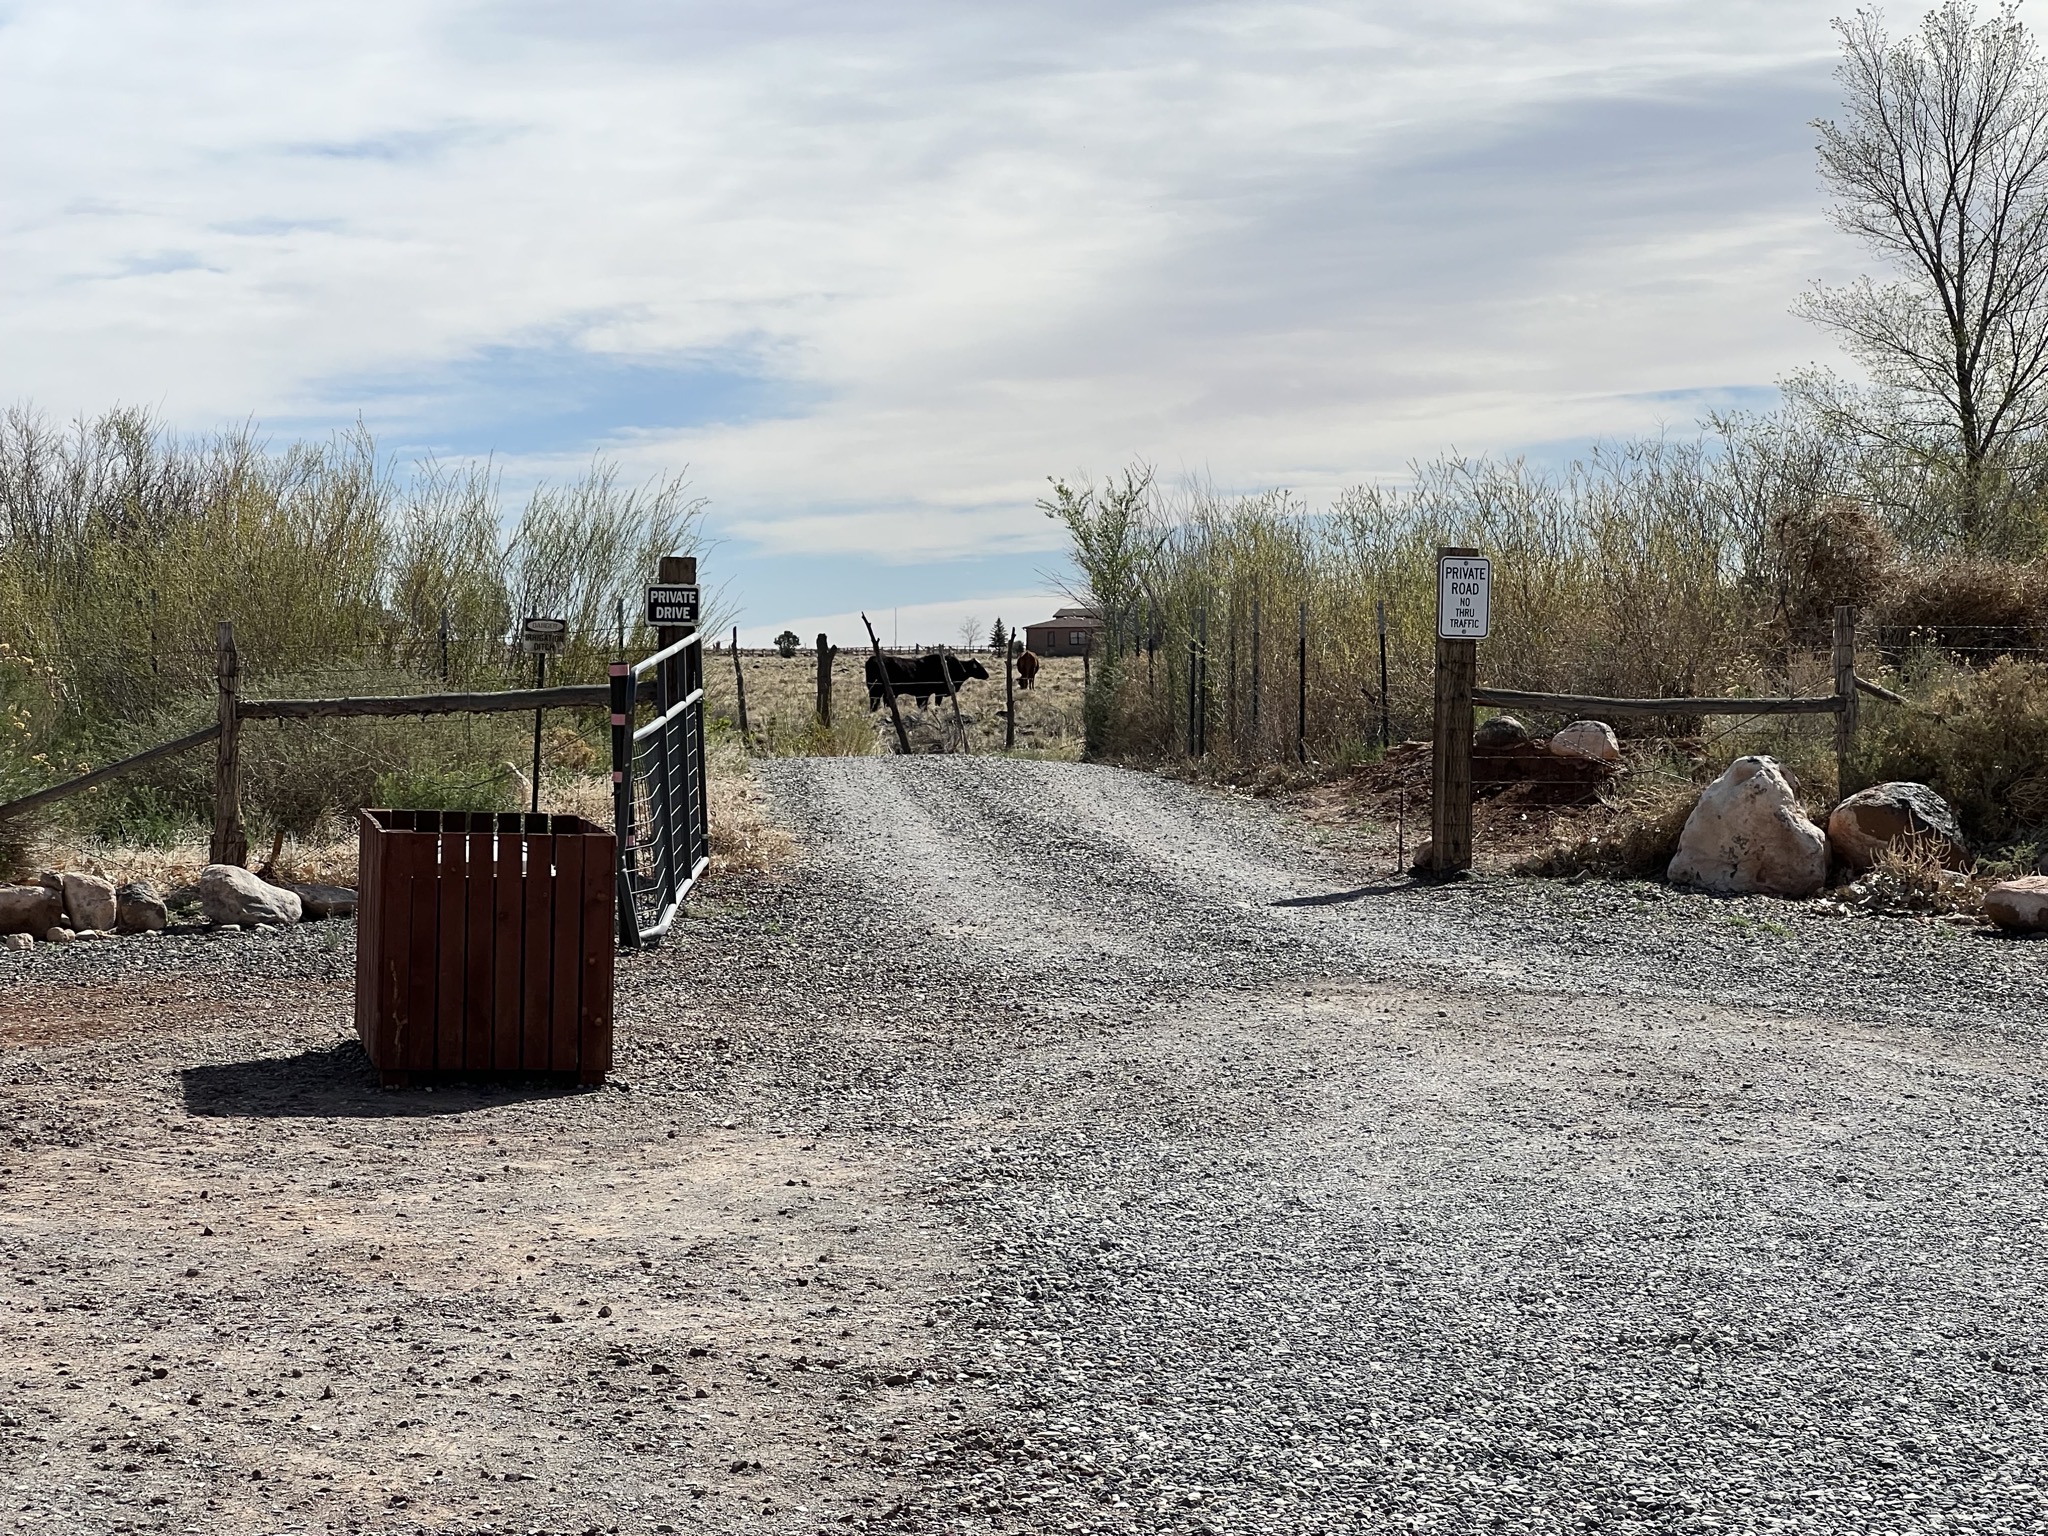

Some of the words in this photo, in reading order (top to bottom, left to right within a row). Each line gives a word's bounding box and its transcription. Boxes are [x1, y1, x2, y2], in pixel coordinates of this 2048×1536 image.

[1445, 567, 1486, 580] PRIVATE
[1451, 582, 1479, 595] ROAD
[650, 590, 696, 604] PRIVATE
[1460, 598, 1470, 606] NO
[656, 606, 690, 619] DRIVE
[1456, 608, 1474, 618] THRU
[1450, 618, 1480, 628] TRAFFIC
